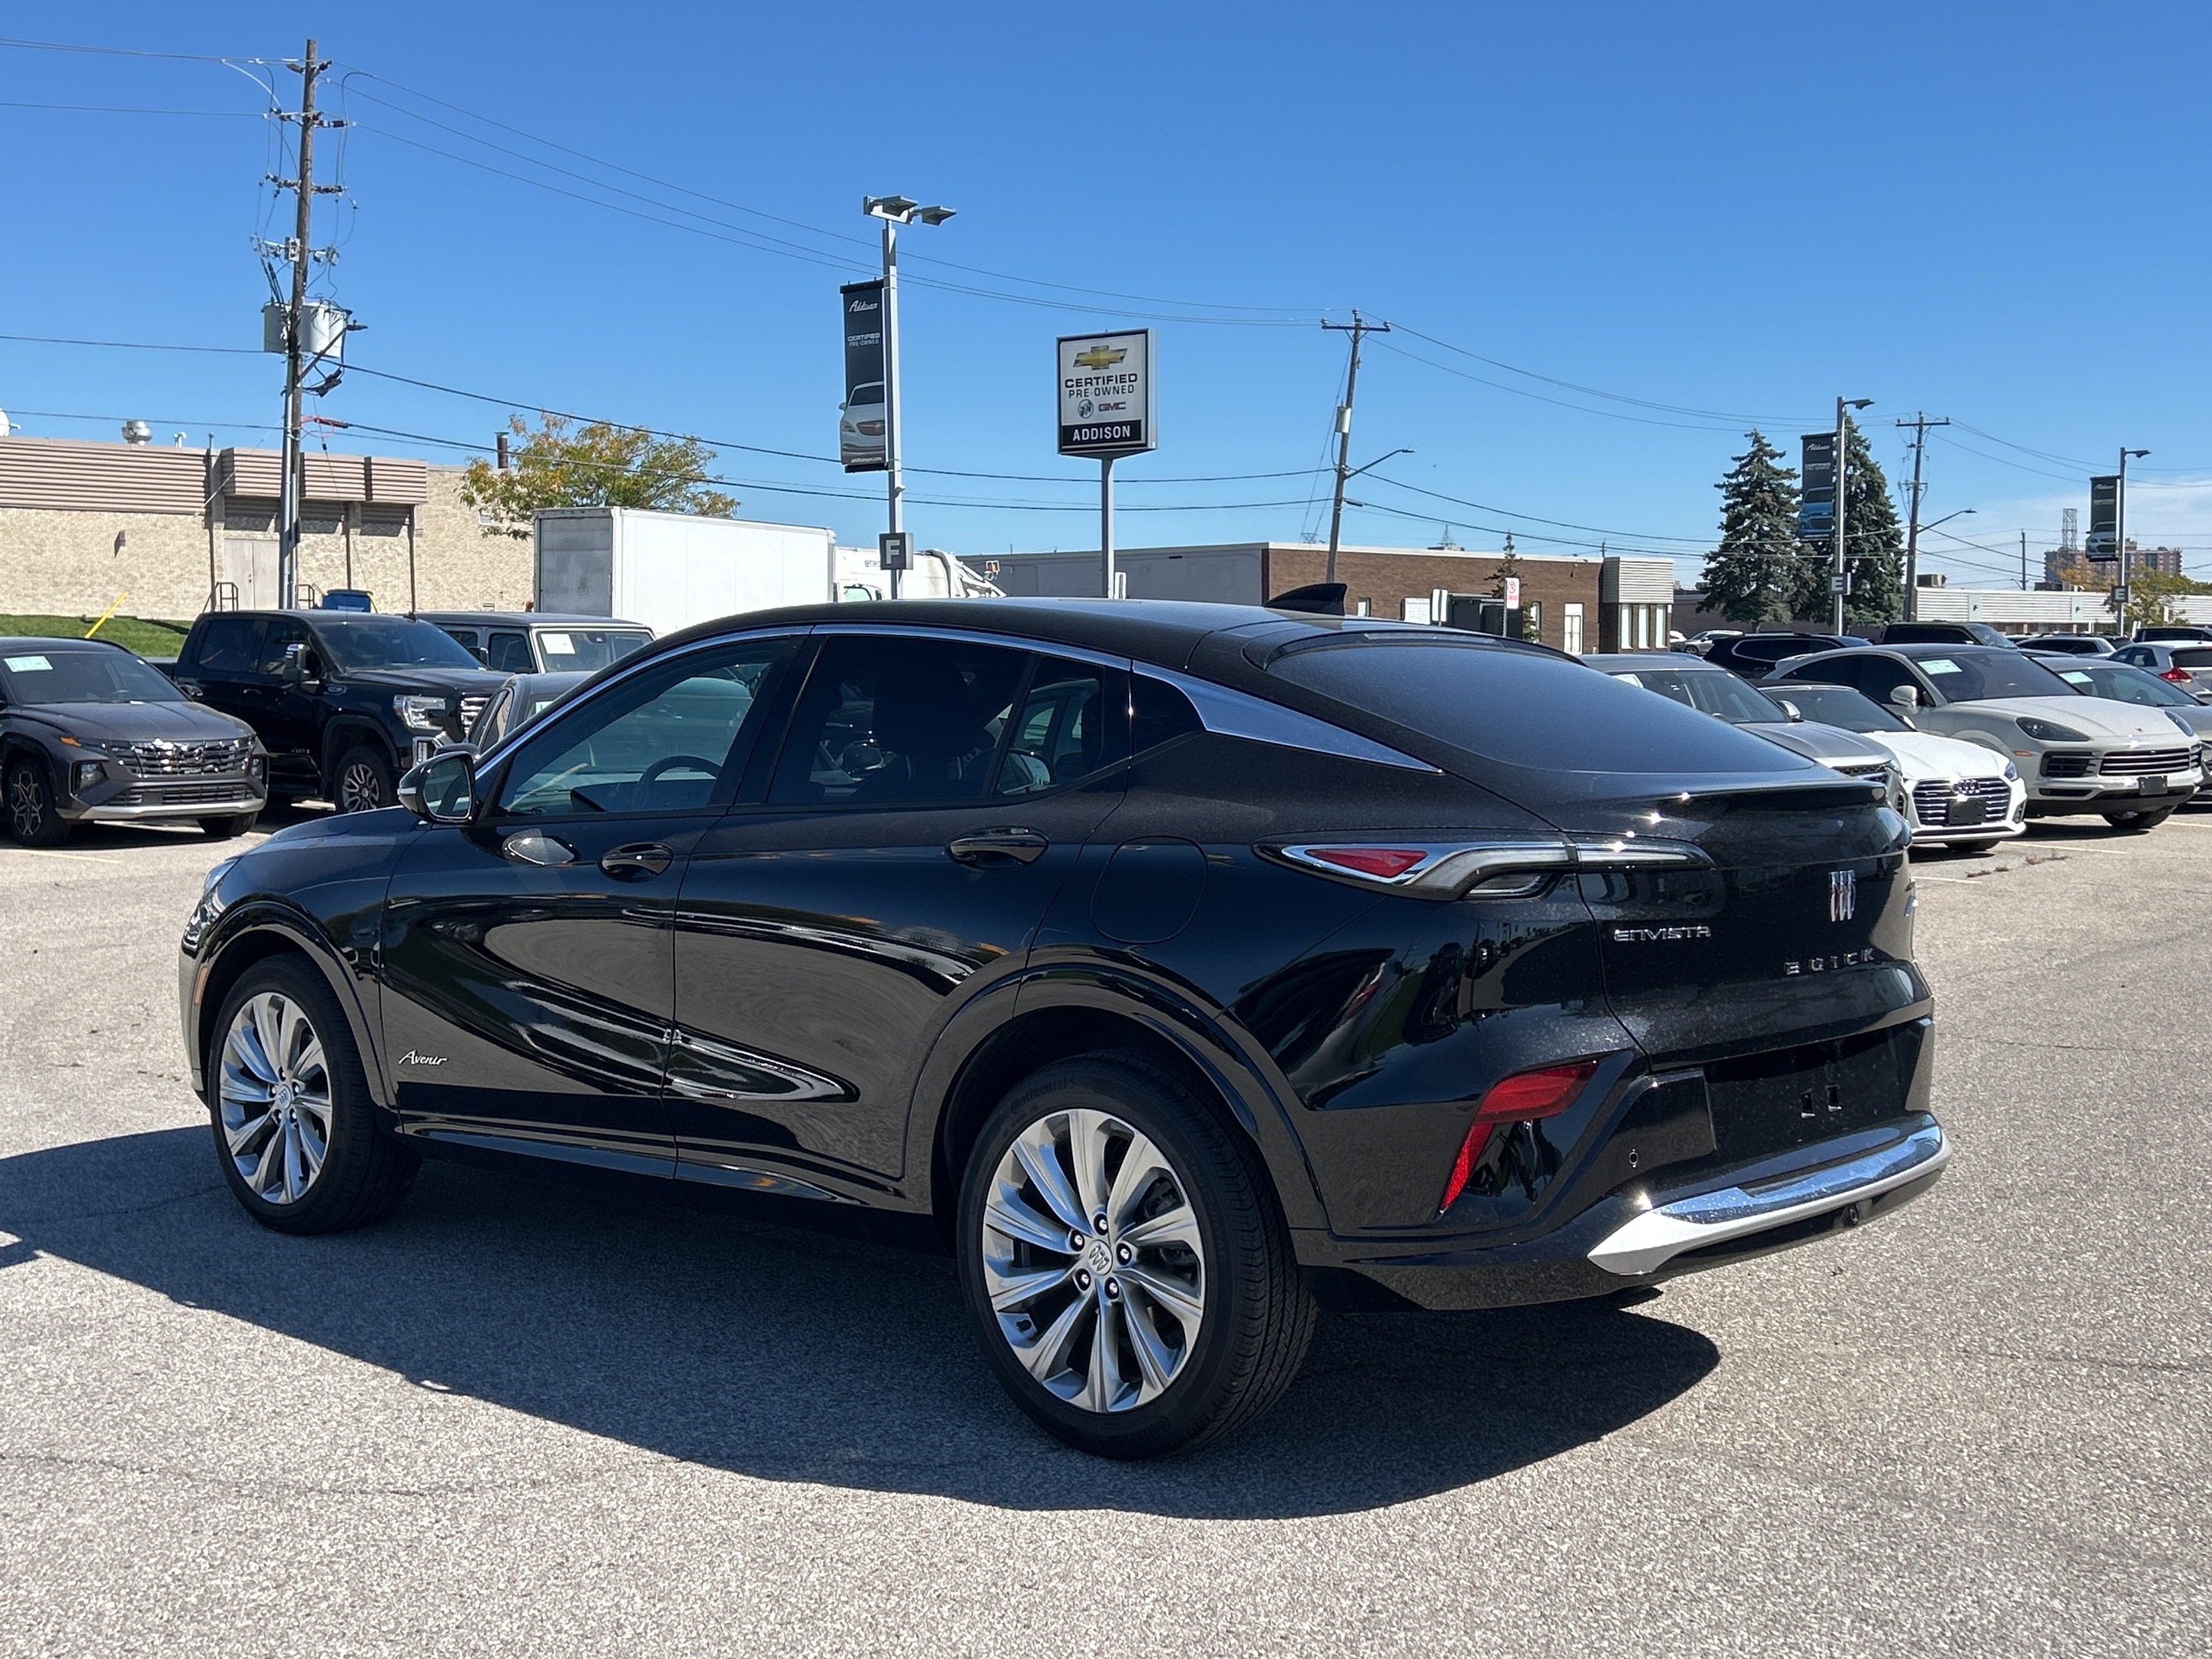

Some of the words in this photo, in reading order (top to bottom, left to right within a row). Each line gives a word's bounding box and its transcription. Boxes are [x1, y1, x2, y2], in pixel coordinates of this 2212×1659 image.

[1065, 373, 1137, 388] CERTIFIED
[1068, 385, 1134, 399] PRE-OWNED
[1098, 402, 1126, 412] GMC
[1072, 426, 1131, 441] ADDISON
[886, 539, 900, 565] F
[1831, 576, 1843, 591] E
[2114, 588, 2125, 600] E
[1614, 926, 1711, 942] ENVISTA
[1783, 949, 1874, 975] BUICK
[399, 1049, 447, 1065] Avenir
